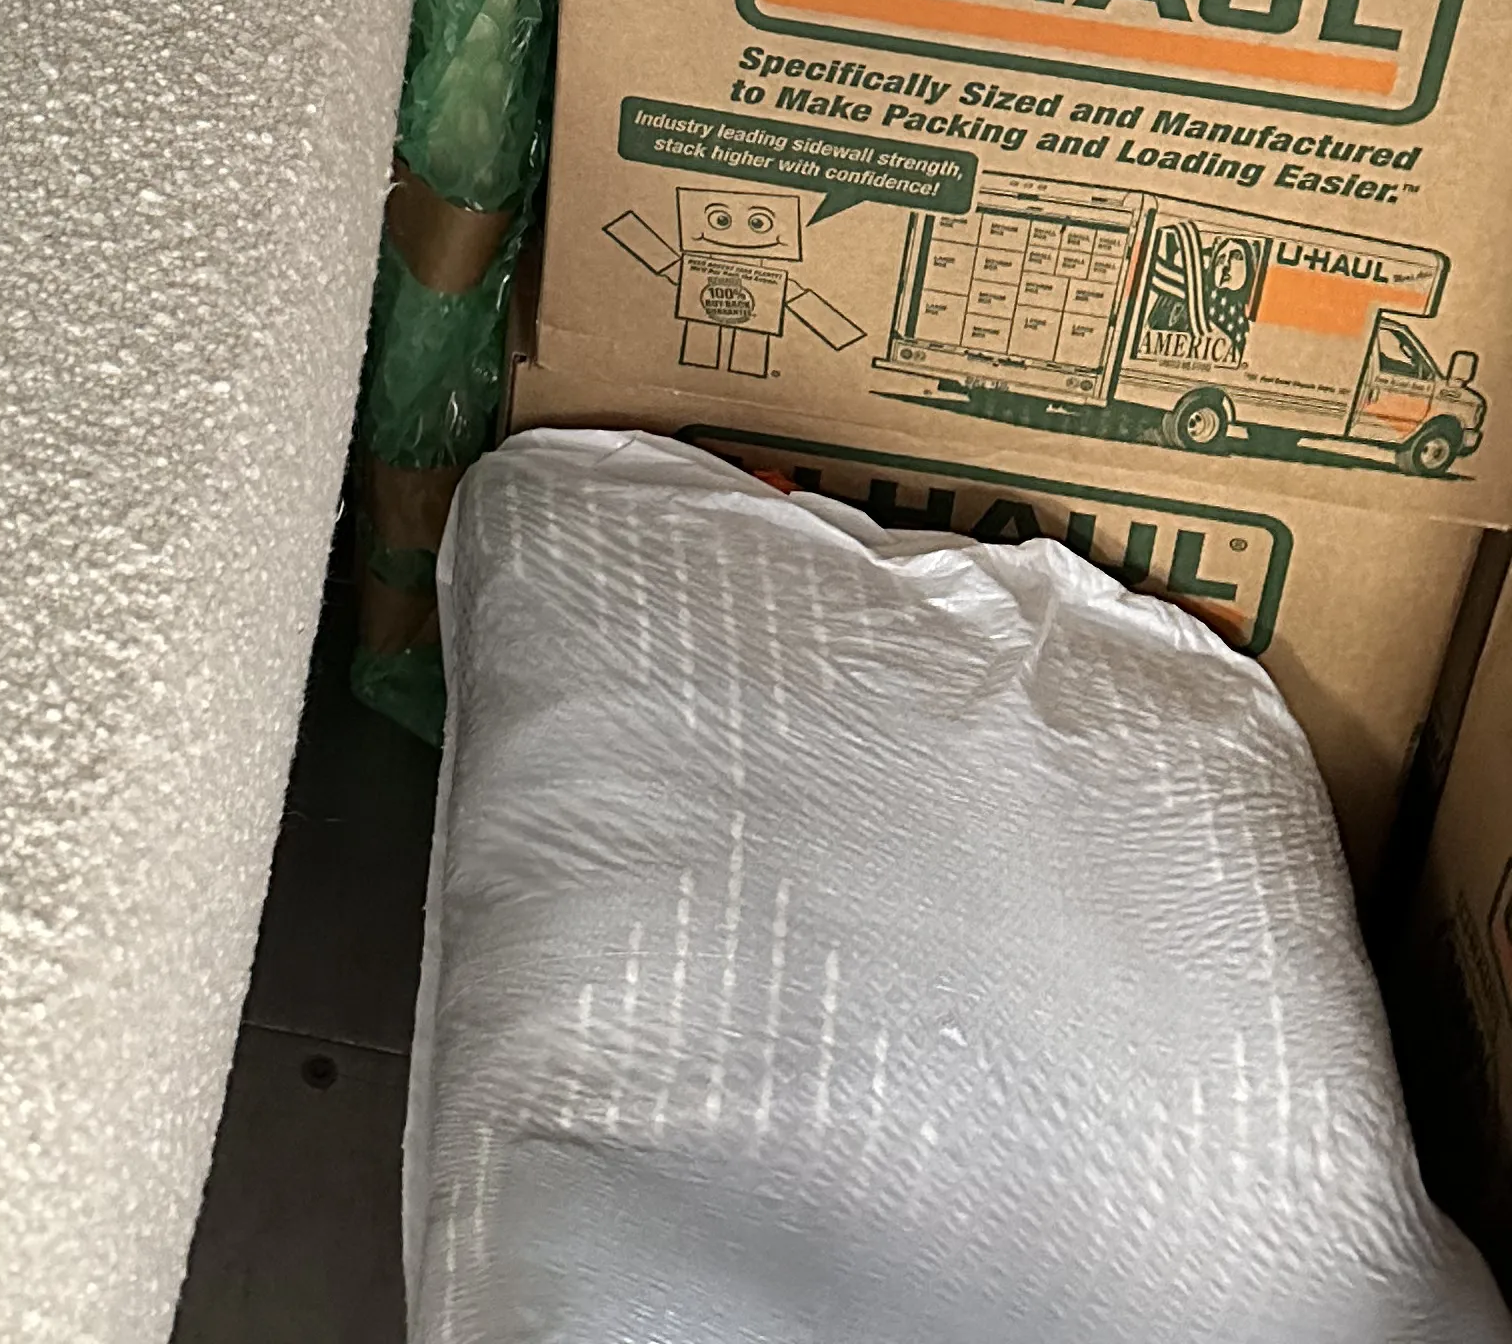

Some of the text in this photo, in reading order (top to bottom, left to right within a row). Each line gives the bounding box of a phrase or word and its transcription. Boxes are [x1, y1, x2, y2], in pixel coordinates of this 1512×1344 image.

[729, 79, 767, 104] to
[774, 86, 874, 123] Make
[880, 102, 1030, 153] Packing
[1034, 126, 1110, 160] and
[1115, 139, 1266, 189] Loading
[737, 45, 1424, 173] Specifically Sized and Manufactured
[633, 108, 965, 181] Industry leading sidewall strength,
[652, 135, 942, 198] stack higher with confidence!
[1275, 241, 1389, 284] U-HAUL
[1139, 329, 1239, 364] AMERICA
